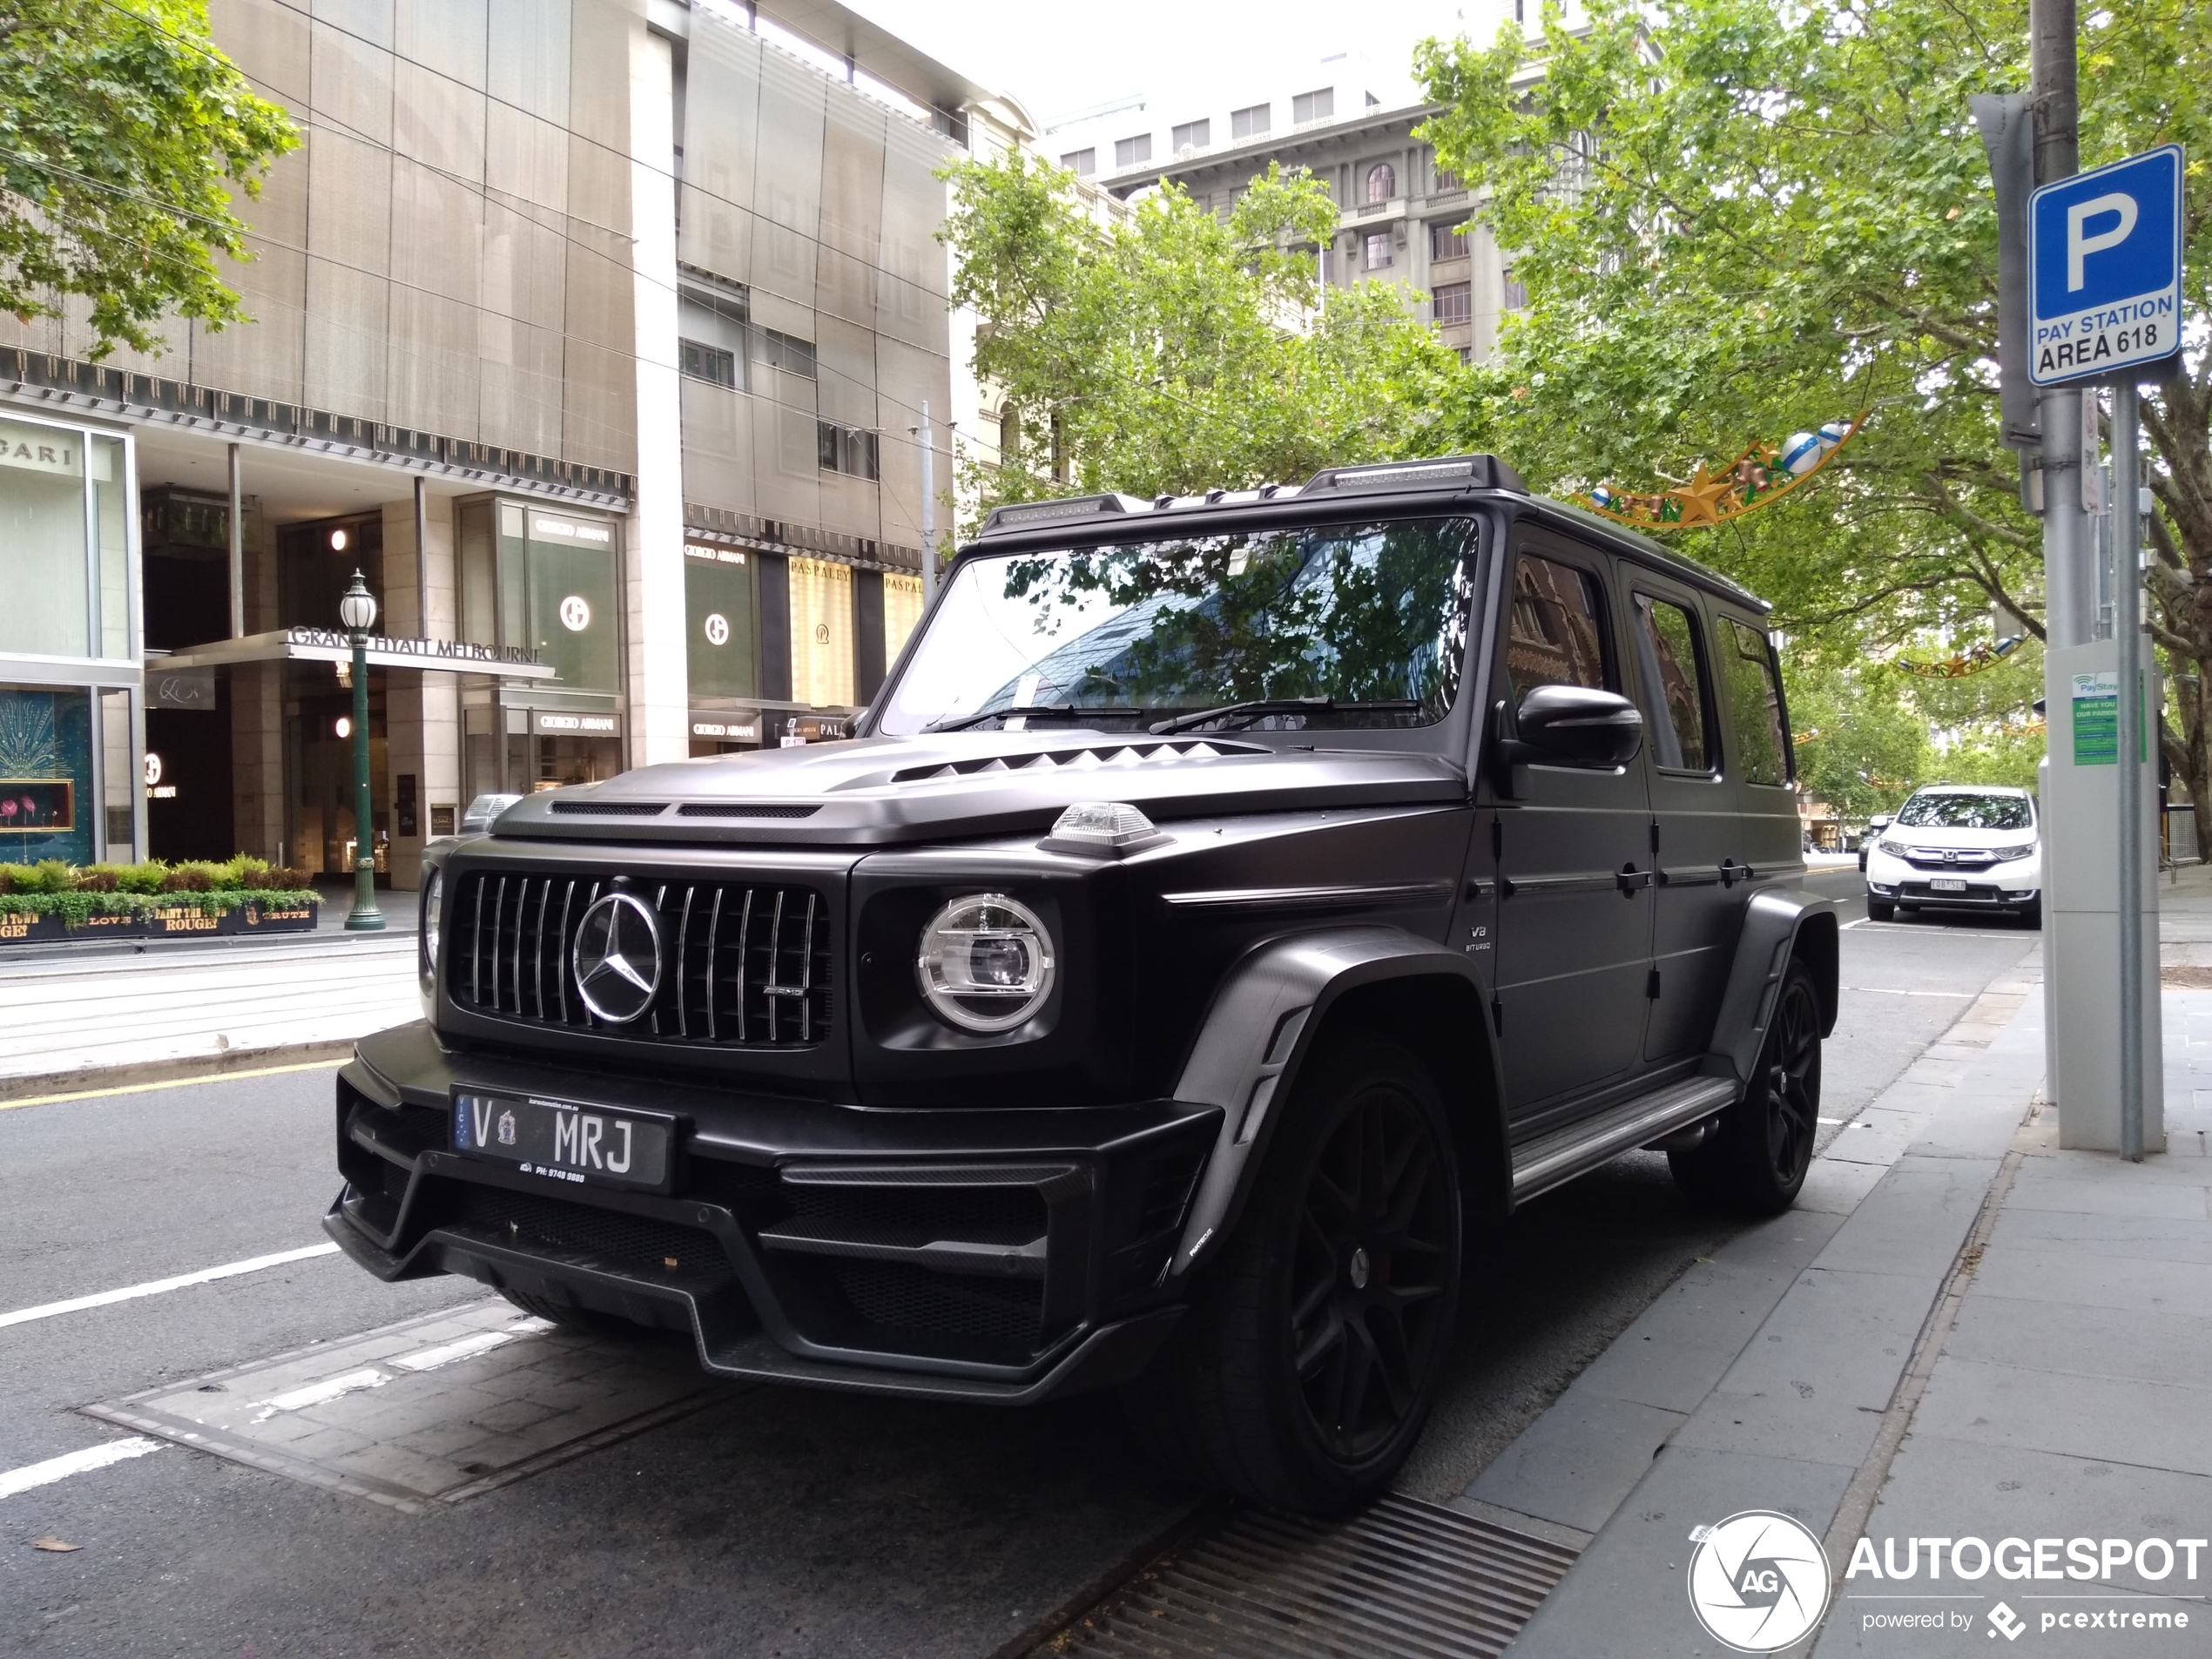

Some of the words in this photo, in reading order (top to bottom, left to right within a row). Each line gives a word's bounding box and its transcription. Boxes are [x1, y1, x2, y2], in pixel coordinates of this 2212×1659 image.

[2067, 192, 2138, 293] P
[2038, 320, 2073, 345] PAY
[2080, 294, 2172, 334] STATION
[2039, 334, 2111, 374] AREA
[2117, 323, 2157, 354] 618
[536, 519, 575, 536] GIORGIO
[576, 526, 609, 542] ARMANI
[684, 544, 716, 559] GIORGIO
[717, 550, 745, 564] ARMANI
[791, 561, 850, 582] PASPALEY
[885, 577, 923, 594] PASPAL
[292, 625, 352, 647] GRAN
[374, 633, 431, 654] HYATT
[435, 639, 542, 664] MELBOURNE
[2080, 683, 2117, 692] PayStay
[540, 716, 579, 729] GIORGIO
[580, 718, 613, 730] ARMANI
[693, 724, 725, 736] GIORGIO
[726, 725, 753, 737] ARMANI
[89, 916, 132, 925] LOVE
[154, 907, 182, 920] PAINT
[262, 911, 309, 920] TRUTH
[1471, 926, 1487, 937] V8
[1466, 942, 1491, 952] BITURBO
[473, 1097, 493, 1148] V
[555, 1111, 632, 1174] MRJ
[536, 1166, 548, 1176] PH:
[549, 1169, 566, 1179] 9748
